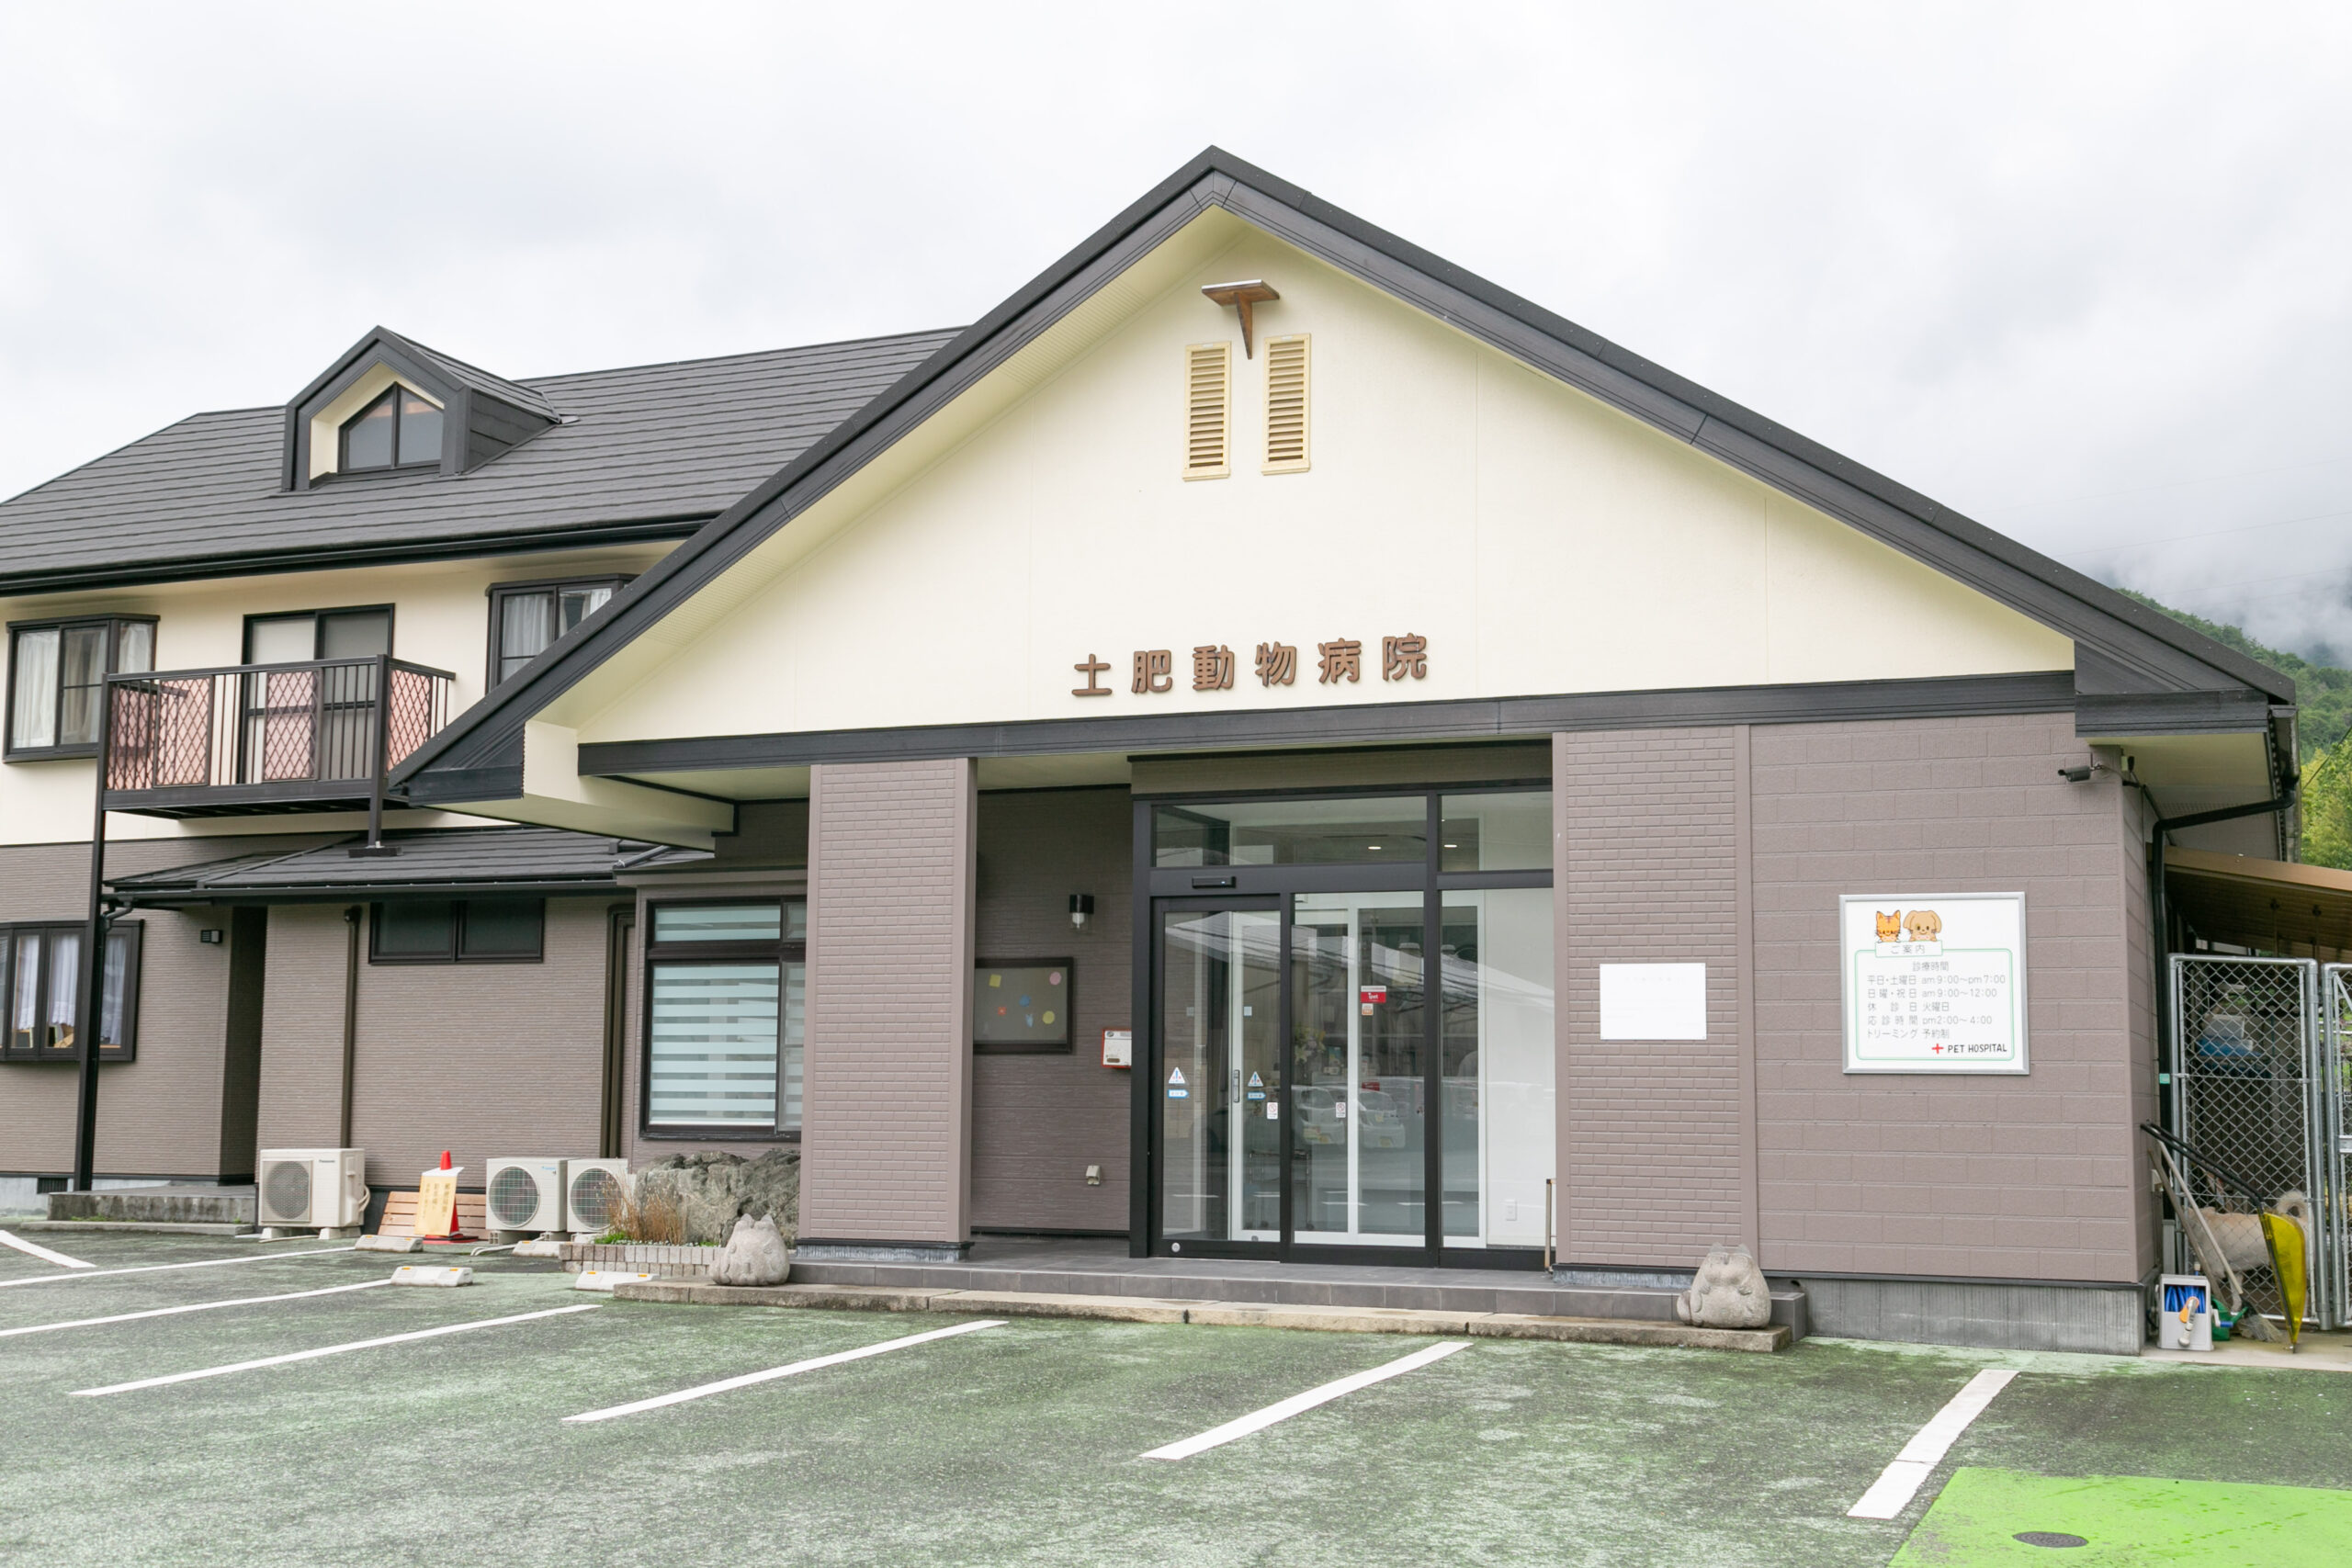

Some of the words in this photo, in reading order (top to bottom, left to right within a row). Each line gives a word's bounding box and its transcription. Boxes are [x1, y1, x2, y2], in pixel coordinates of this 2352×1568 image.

[1071, 632, 1427, 697] 土肥動物病院
[1891, 944, 1926, 954] ご案内
[1912, 961, 1950, 972] 診療時間
[1923, 1001, 1950, 1012] 火曜日
[1947, 1043, 1965, 1054] PET
[1968, 1043, 2007, 1054] HOSPITAL
